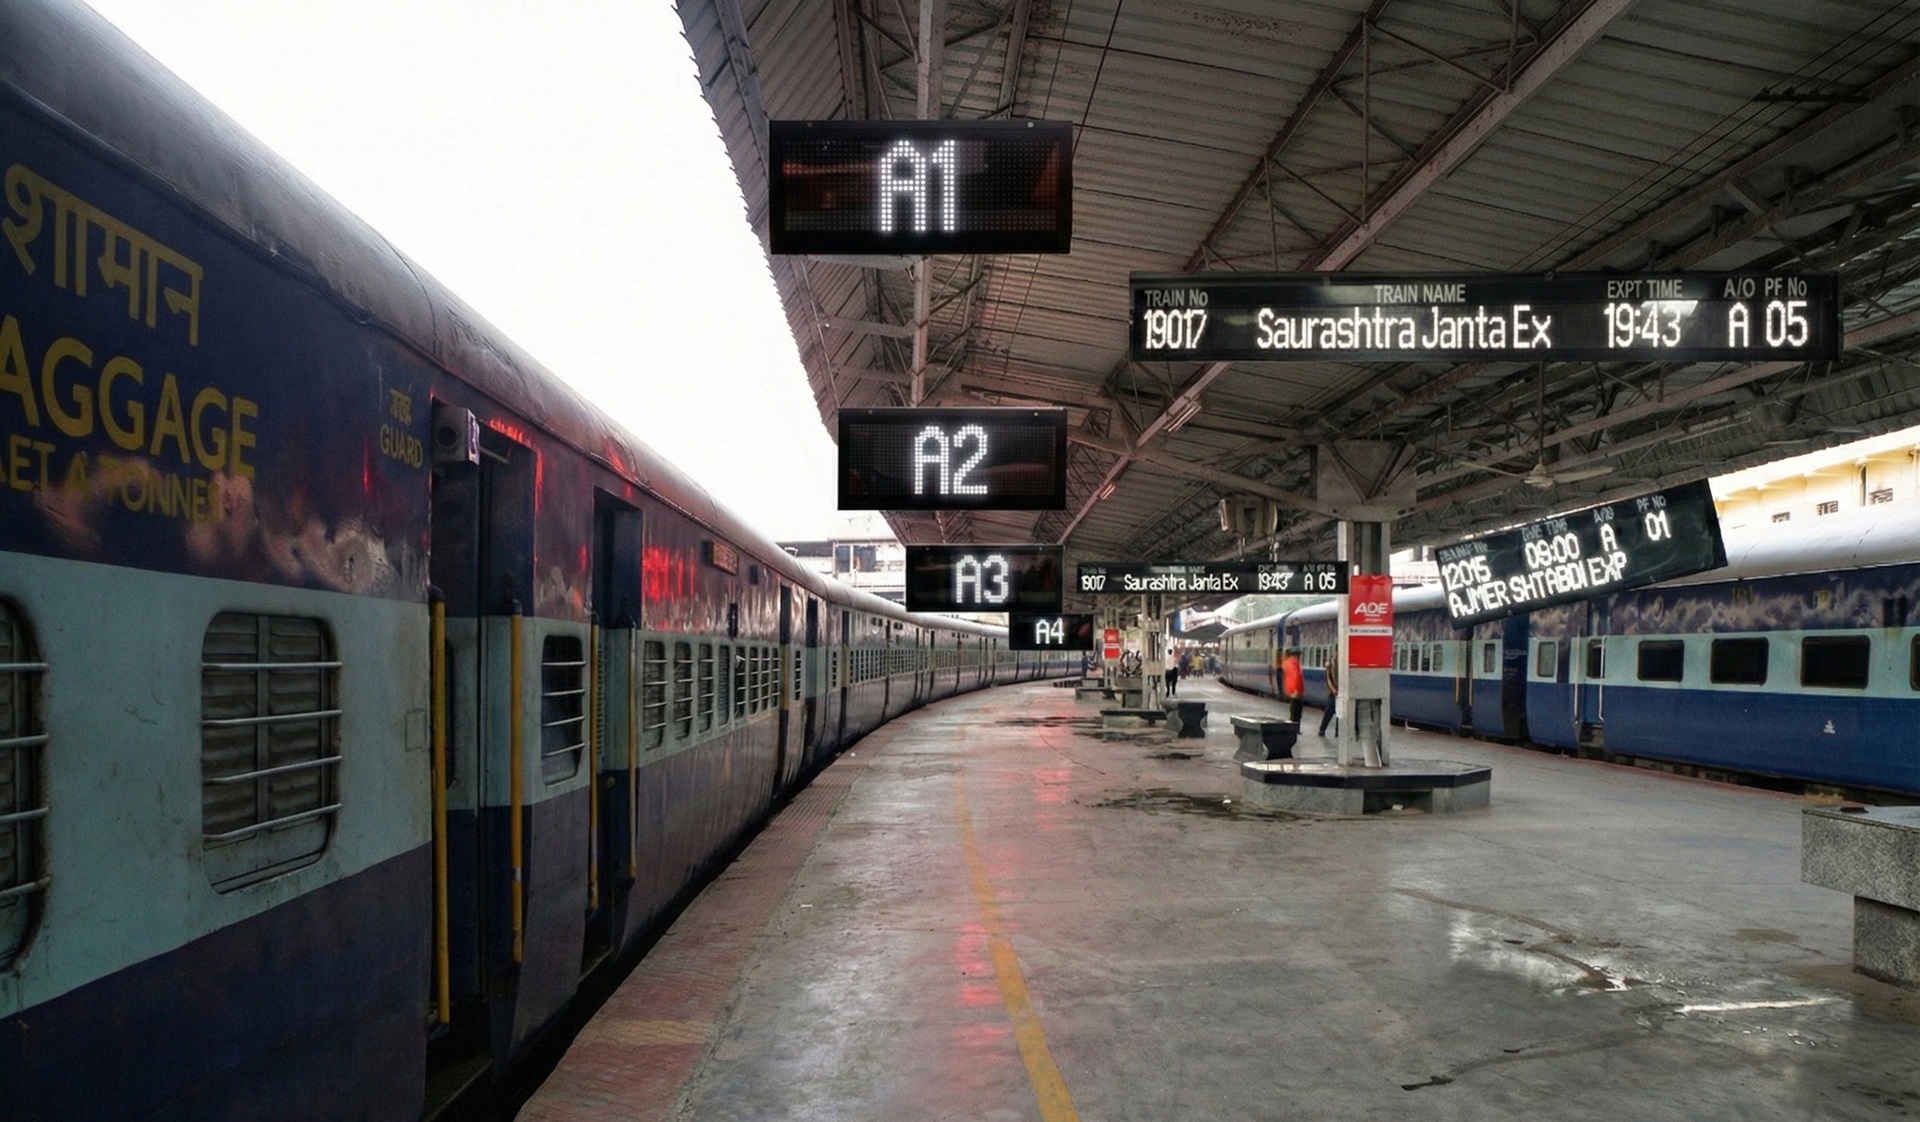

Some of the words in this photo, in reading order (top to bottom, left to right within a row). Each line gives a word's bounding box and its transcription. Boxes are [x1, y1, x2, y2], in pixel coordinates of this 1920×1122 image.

[881, 139, 955, 232] A1
[1144, 289, 1185, 307] TRAIN
[1189, 288, 1209, 307] No
[1374, 284, 1418, 303] TRAIN
[1423, 283, 1466, 302] NAME
[1607, 280, 1643, 299] EXPT
[1646, 279, 1683, 298] TIME
[1723, 277, 1756, 298] A/O
[1764, 277, 1784, 297] PF
[1787, 276, 1808, 297] No
[1143, 308, 1208, 350] 19017
[1257, 306, 1416, 350] Saurashtra
[1422, 305, 1506, 350] Janta
[1513, 304, 1551, 349] Ex
[1604, 302, 1683, 349] 19:43
[1728, 301, 1749, 348] A
[1765, 300, 1808, 347] 05
[380, 422, 423, 470] GUARD
[914, 425, 988, 495] A2
[1441, 555, 1491, 591] 12015
[1524, 532, 1581, 569] 09:00
[1600, 524, 1618, 552] A
[1644, 509, 1671, 541] 01
[955, 554, 1009, 604] A3
[1123, 573, 1187, 592] Saurashtra
[1188, 573, 1221, 591] Janta
[1222, 572, 1239, 591] Ex
[1304, 572, 1314, 591] A
[1318, 572, 1337, 590] 05
[1448, 581, 1511, 618] AJMER
[1509, 561, 1589, 603] SHTABDI
[1587, 551, 1627, 587] EXP
[1035, 617, 1065, 644] A4
